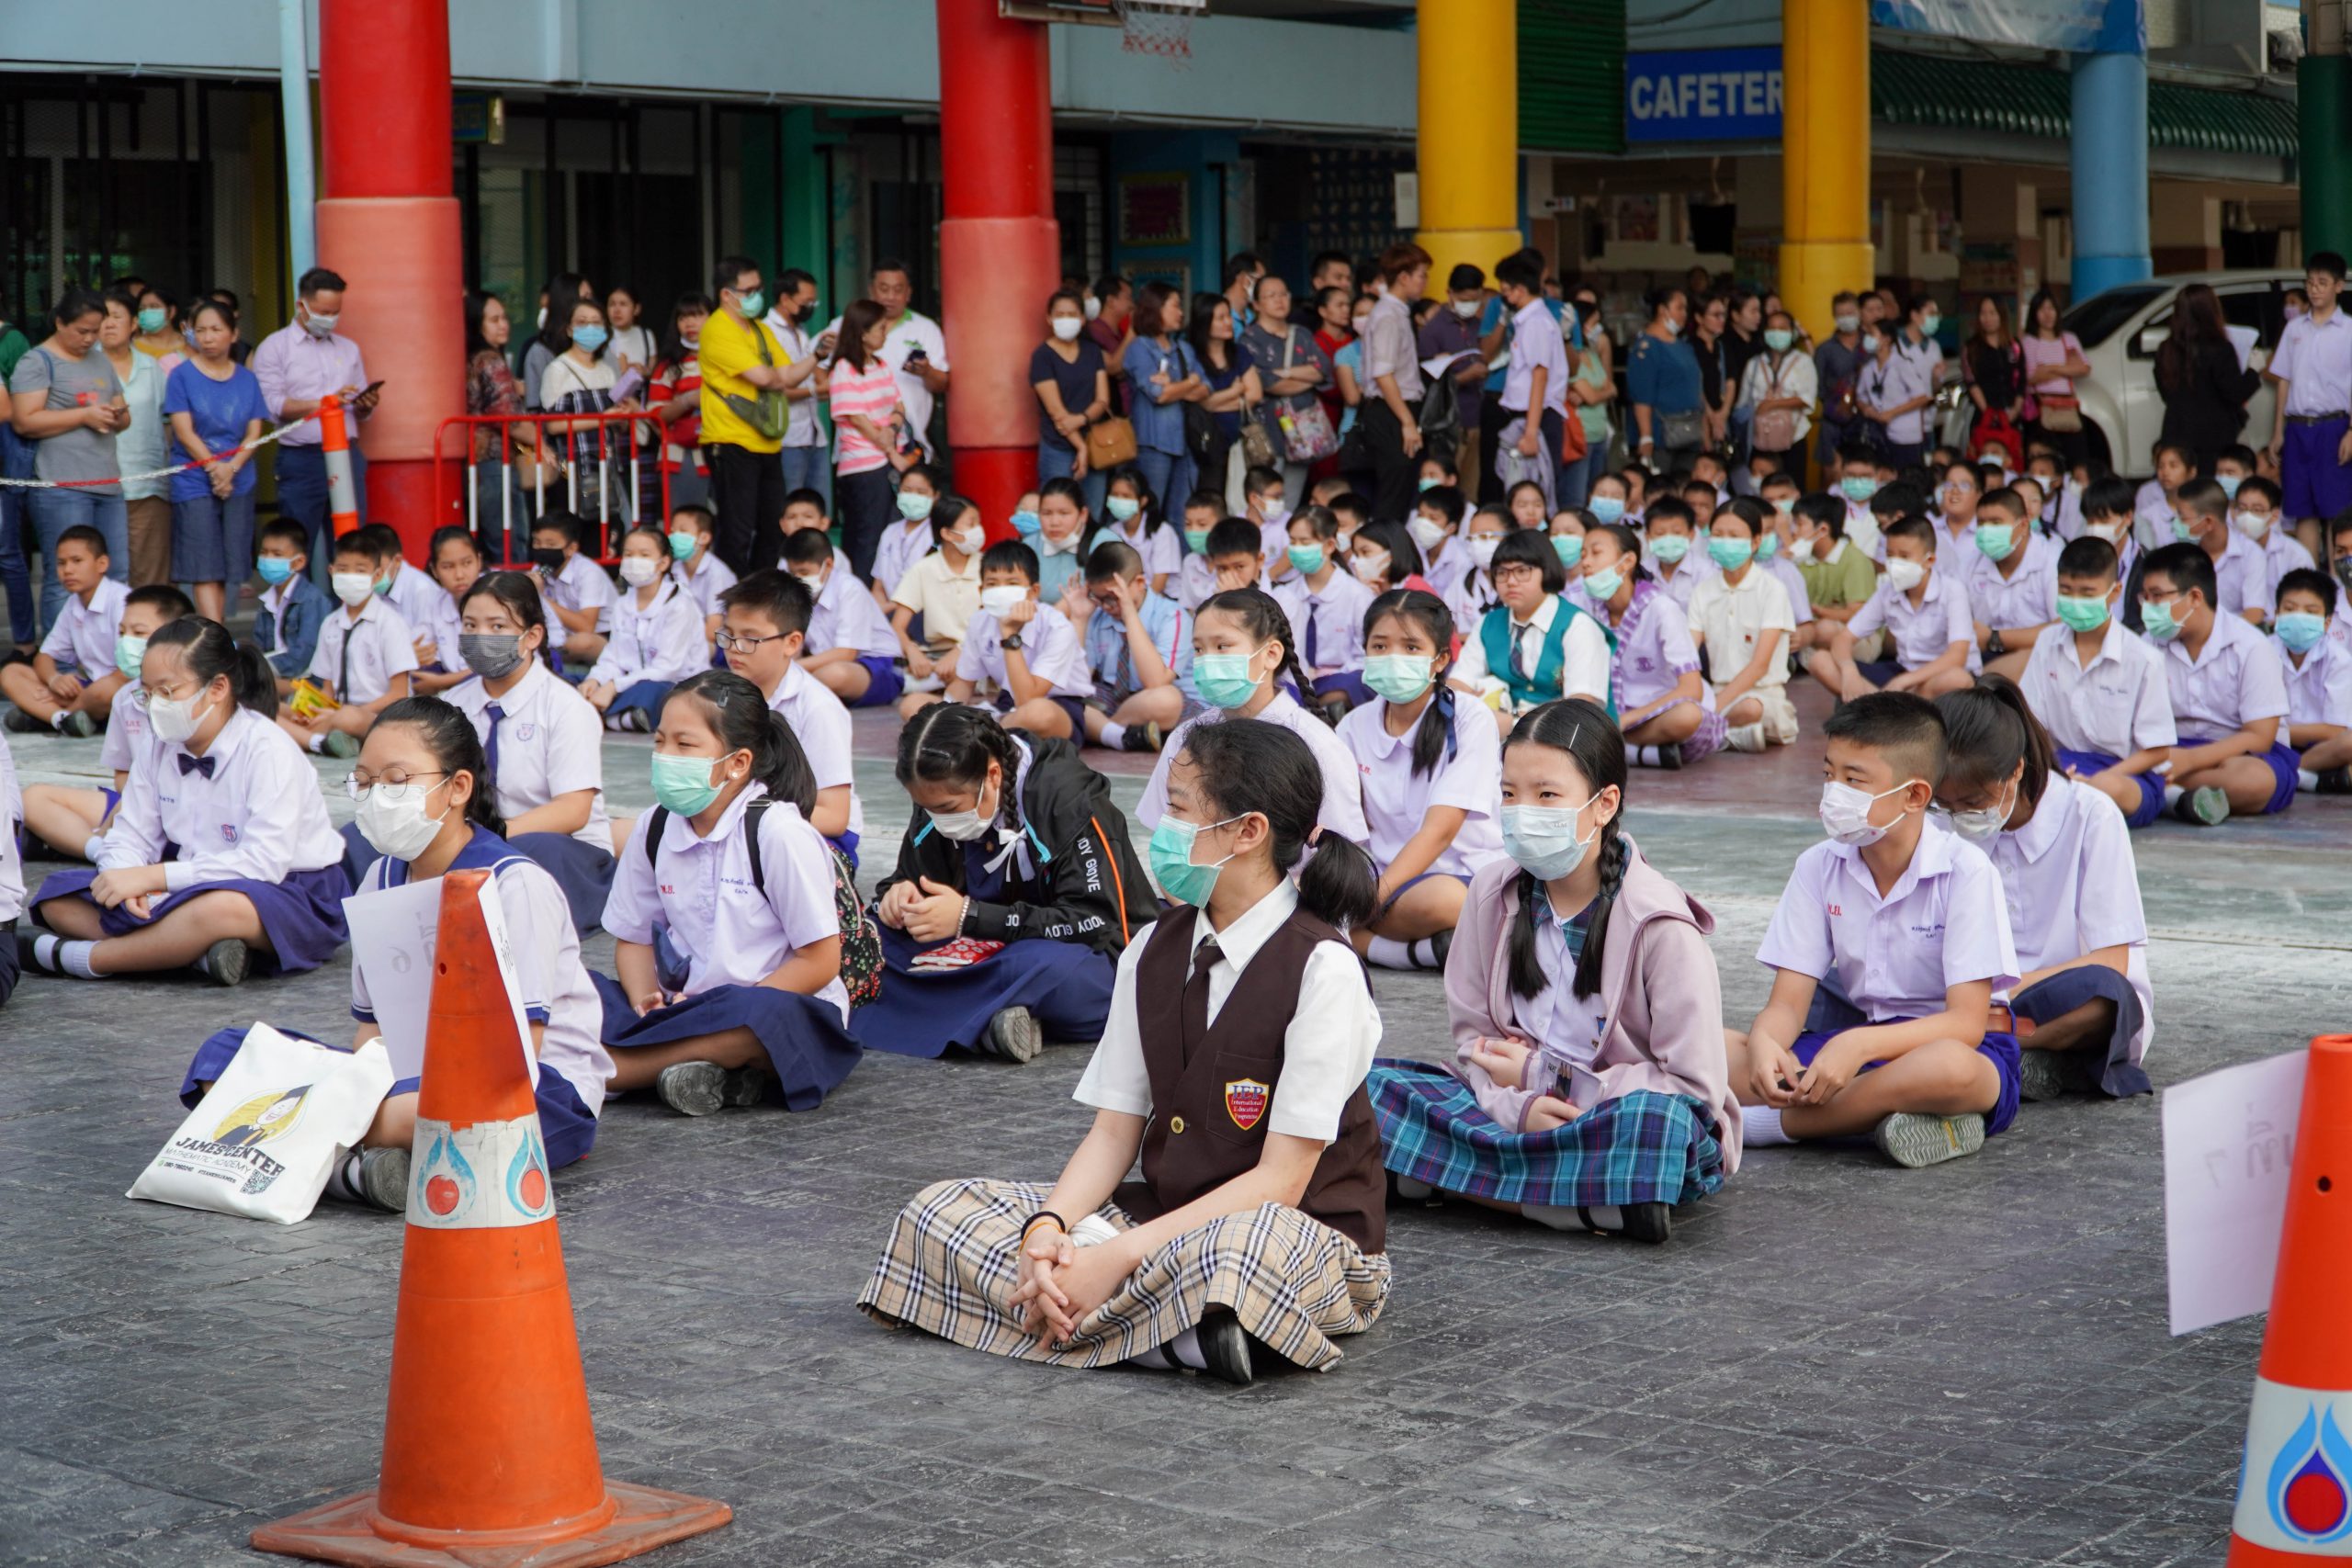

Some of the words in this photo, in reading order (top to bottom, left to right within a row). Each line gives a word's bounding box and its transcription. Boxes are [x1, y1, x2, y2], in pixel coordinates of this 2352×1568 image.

[1630, 70, 1783, 120] CAFETER
[1077, 837, 1093, 855] DY
[1232, 1085, 1264, 1100] IEP
[175, 1137, 225, 1156] JAMES
[164, 1147, 214, 1163] MATHEMATIC
[211, 1156, 252, 1175] ACADEMY
